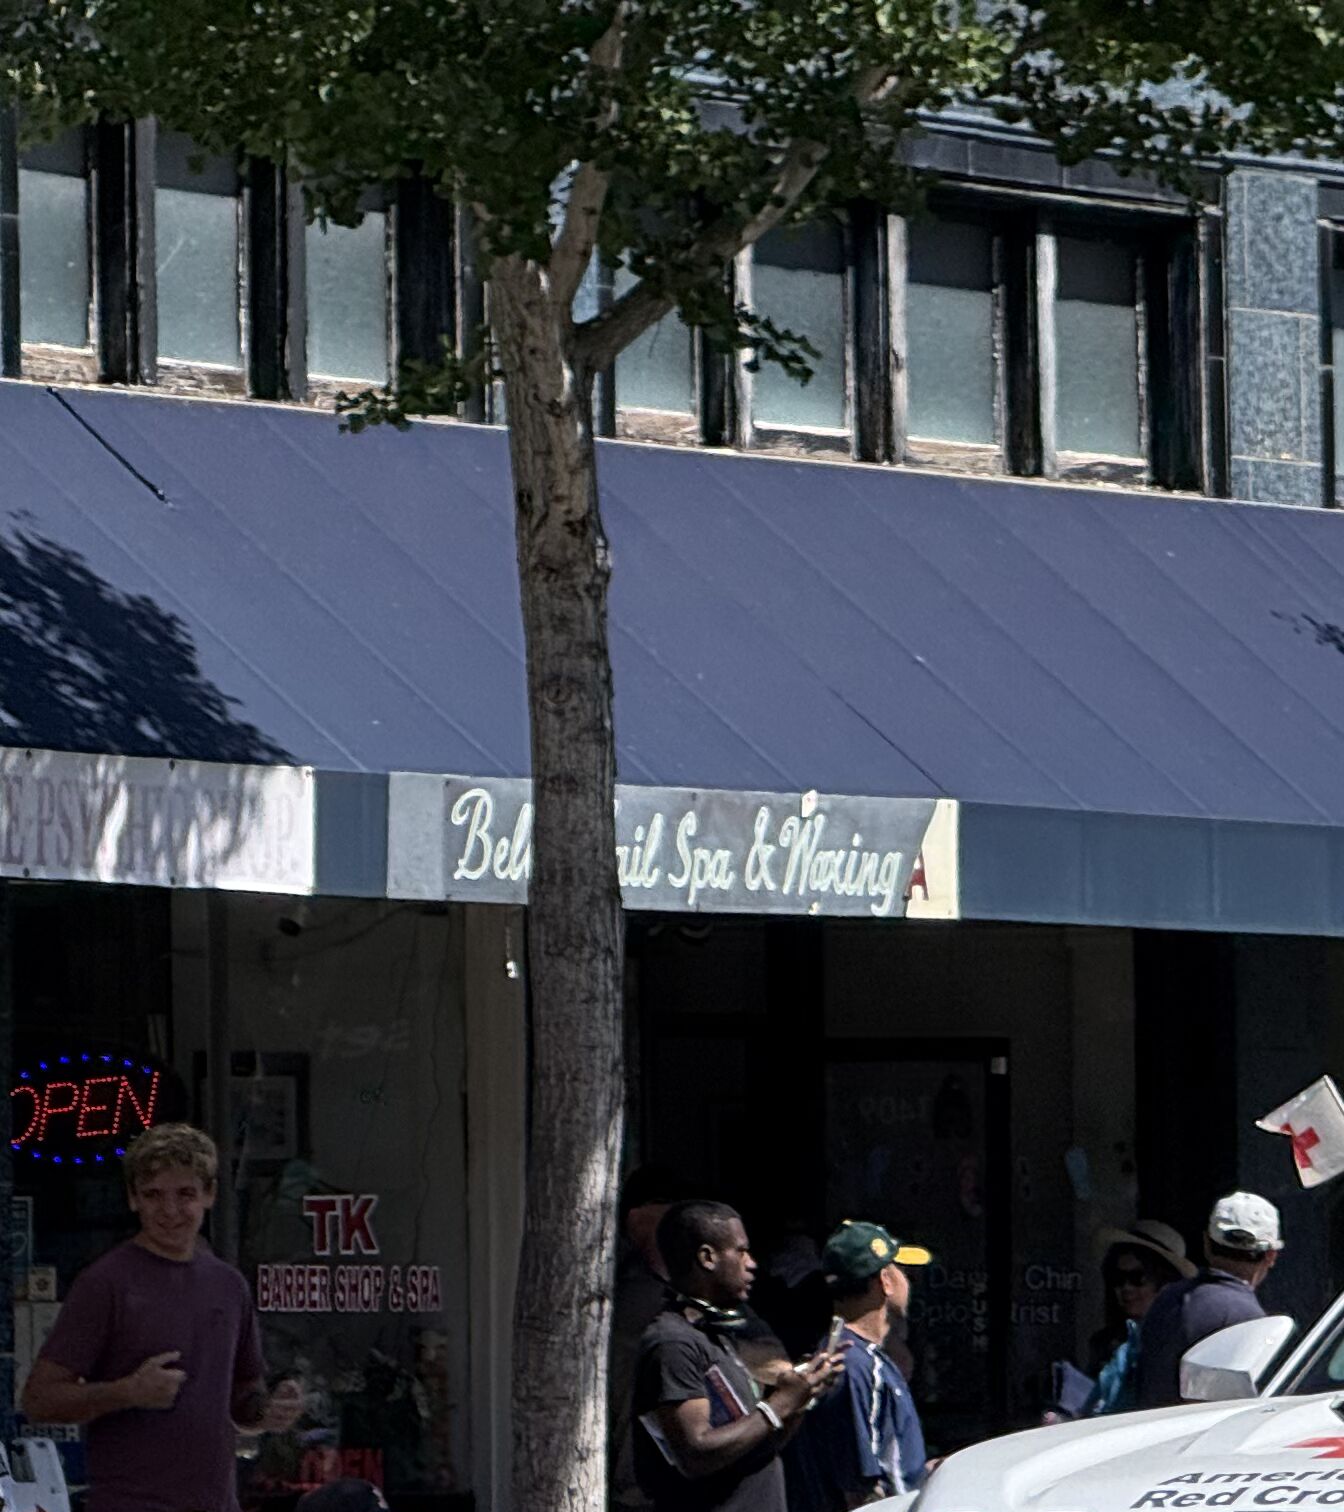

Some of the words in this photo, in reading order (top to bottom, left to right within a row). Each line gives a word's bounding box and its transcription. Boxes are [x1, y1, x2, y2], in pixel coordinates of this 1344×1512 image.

[667, 810, 734, 906] Spa
[744, 805, 778, 892] &
[779, 808, 903, 916] Waxing
[11, 1070, 159, 1143] OPEN
[303, 1194, 379, 1256] TK
[257, 1263, 332, 1312] BARBER
[335, 1265, 384, 1313] SHOP
[389, 1265, 403, 1312] &
[407, 1265, 442, 1312] SPA
[1025, 1264, 1082, 1291] Chin
[1130, 1486, 1247, 1509] Red
